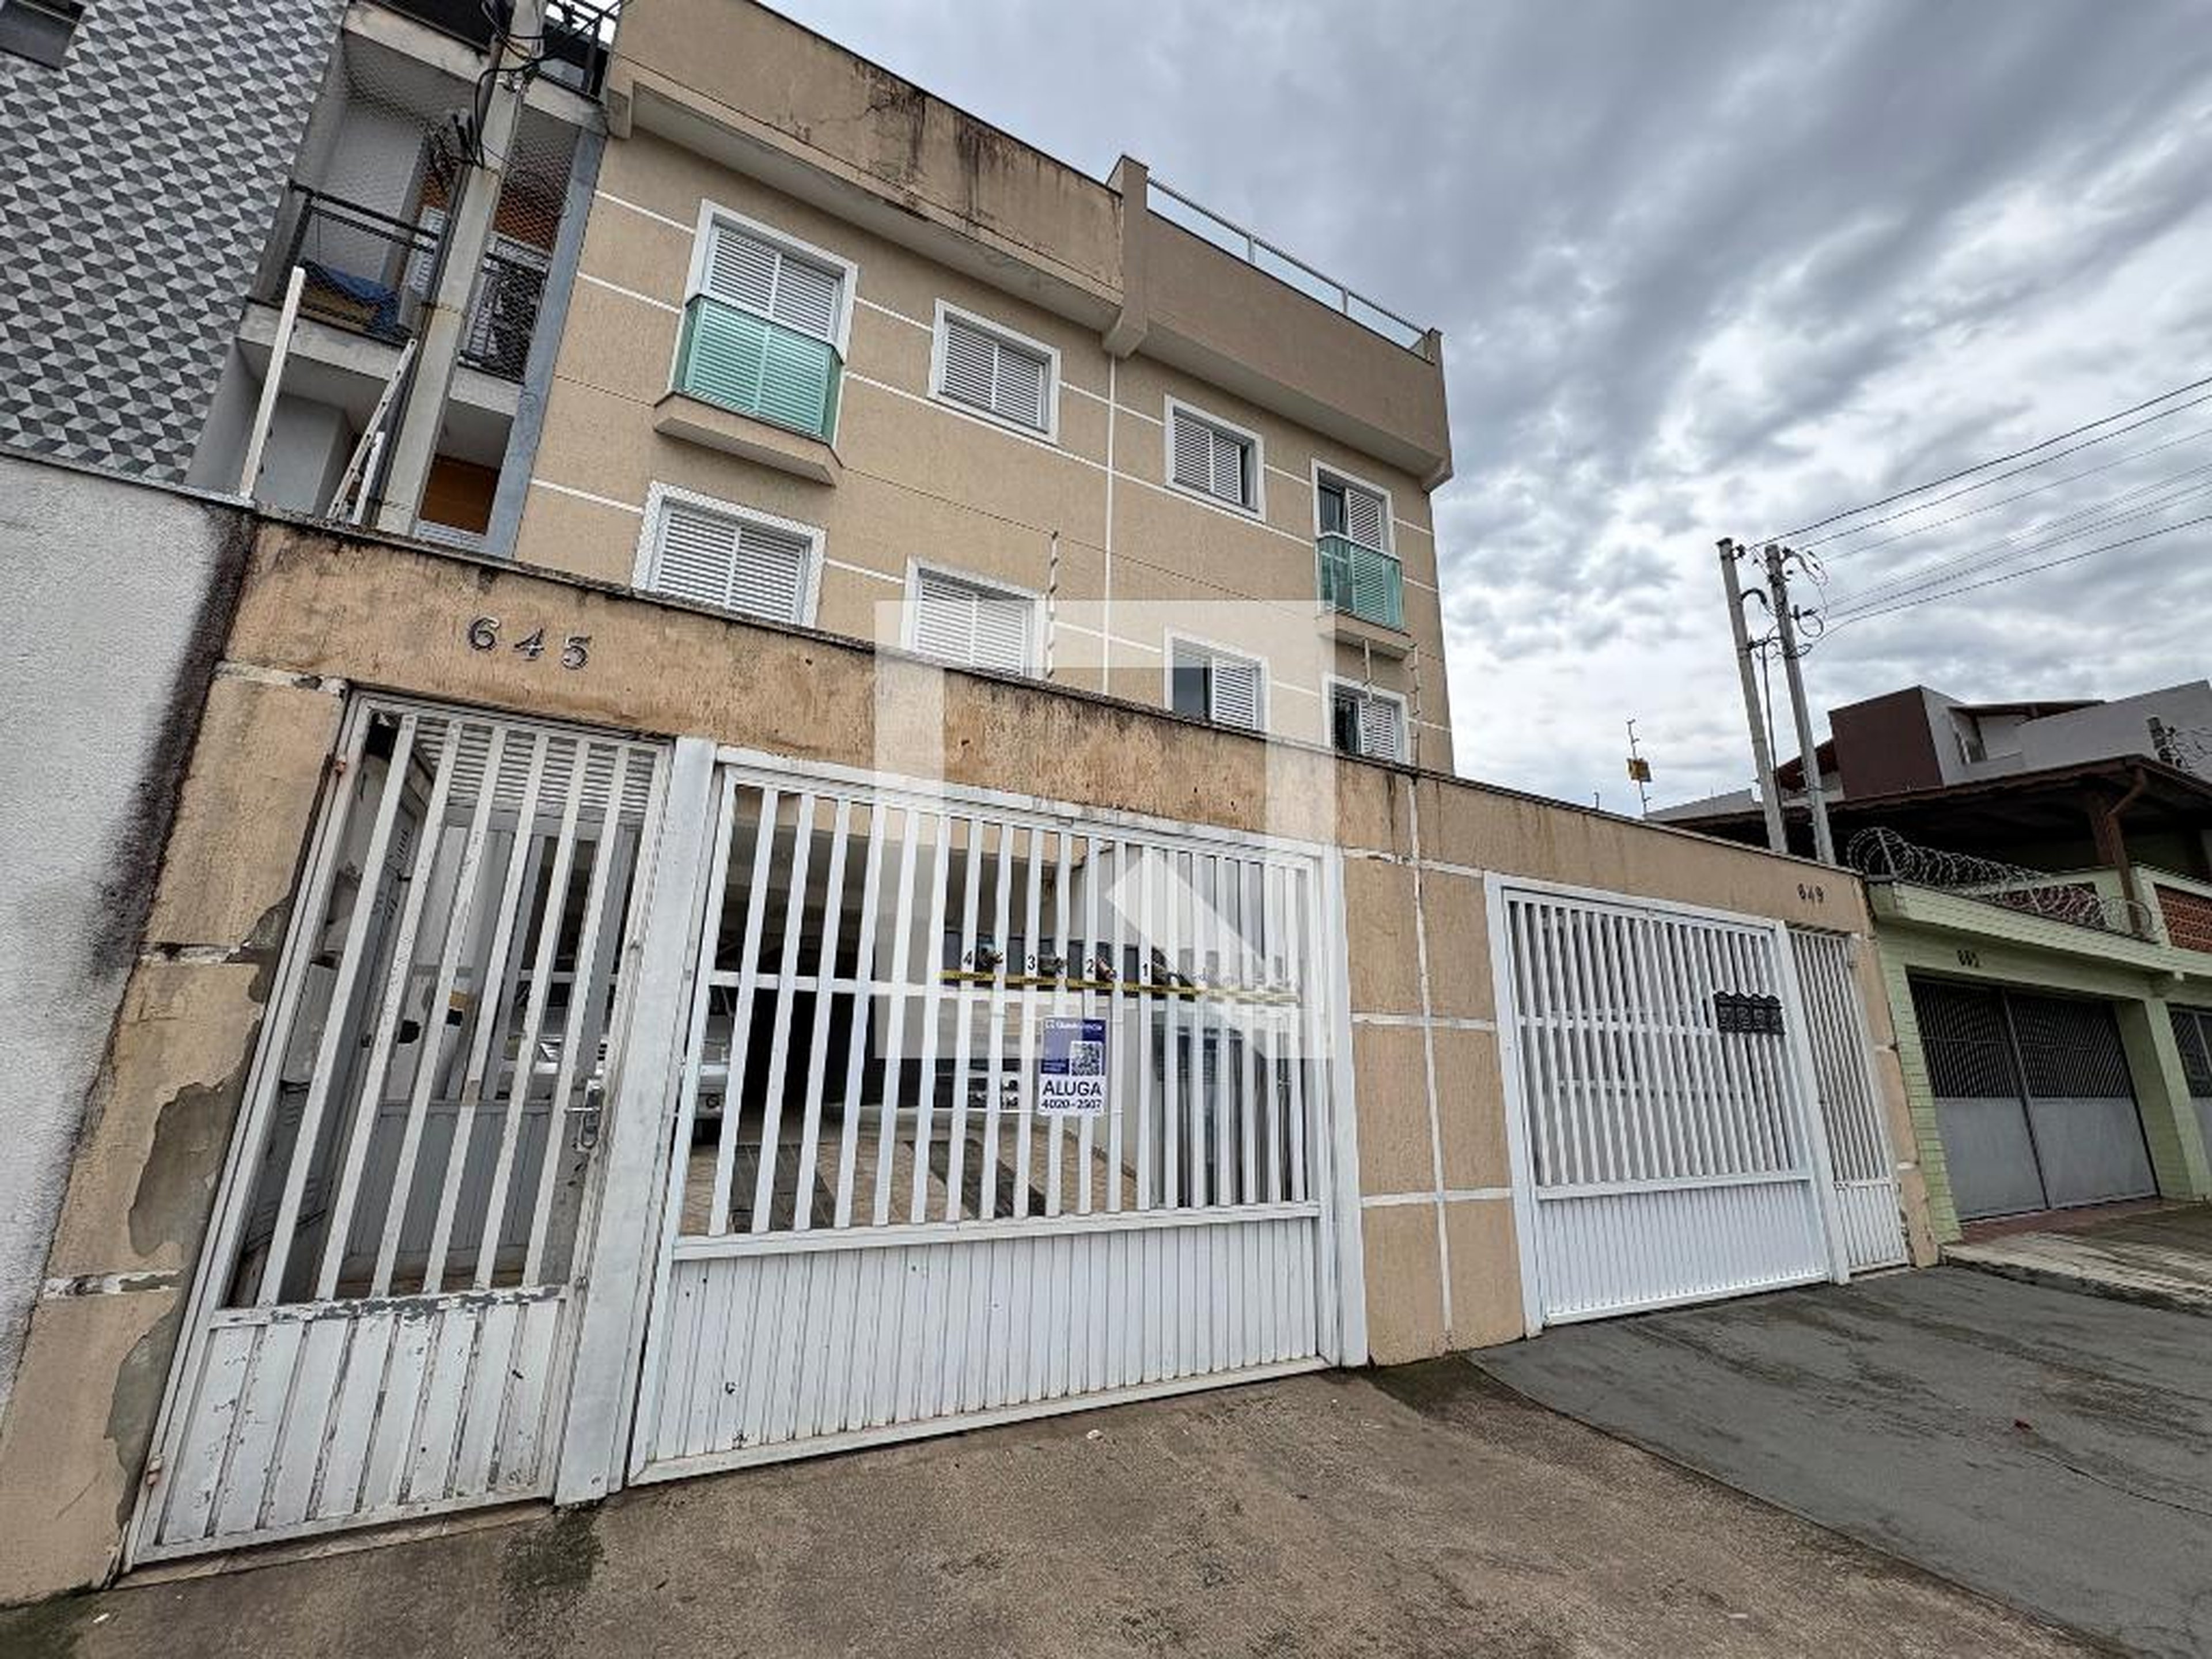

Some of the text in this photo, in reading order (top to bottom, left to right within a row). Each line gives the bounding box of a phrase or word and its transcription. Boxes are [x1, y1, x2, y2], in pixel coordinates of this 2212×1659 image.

[467, 616, 592, 670] 645
[1027, 954, 1036, 970] 3
[1086, 959, 1093, 973] 2
[1043, 1081, 1102, 1096] ALUGA
